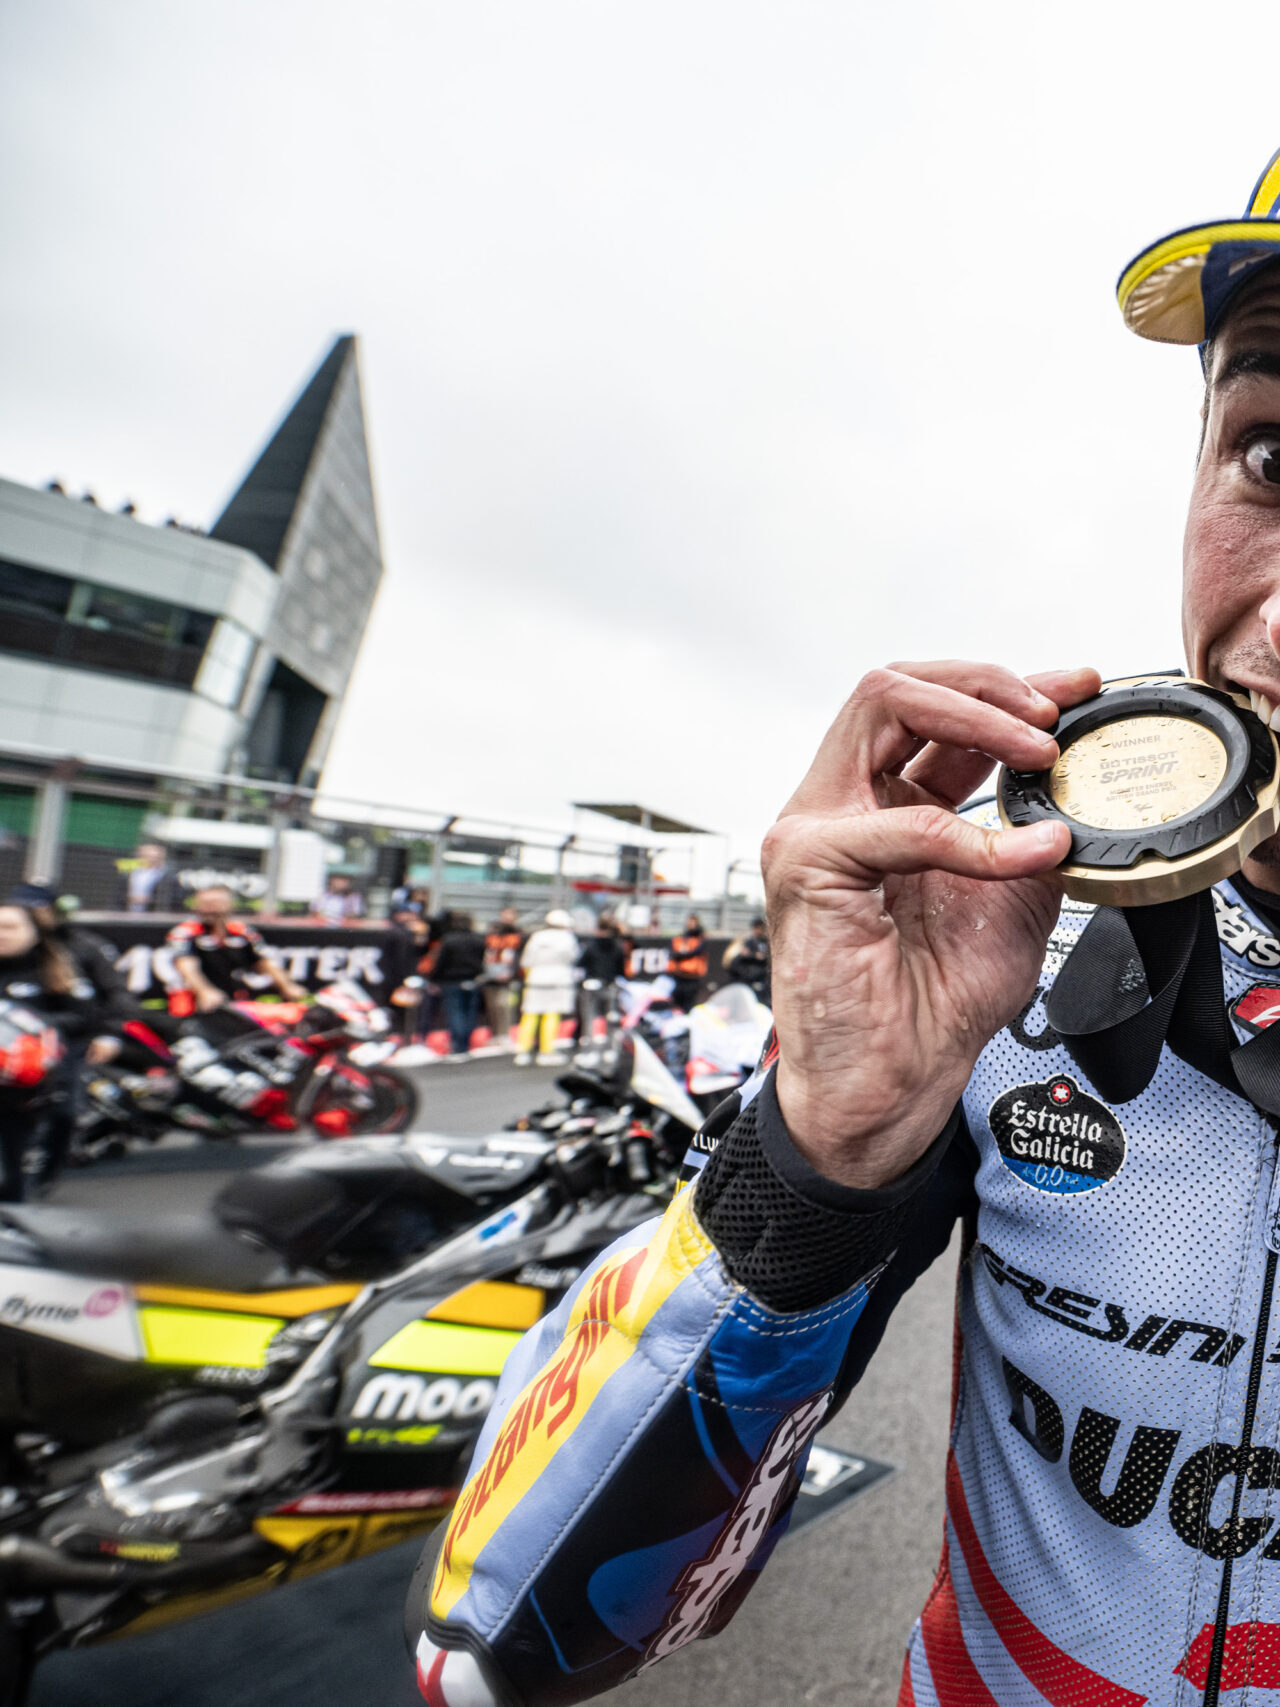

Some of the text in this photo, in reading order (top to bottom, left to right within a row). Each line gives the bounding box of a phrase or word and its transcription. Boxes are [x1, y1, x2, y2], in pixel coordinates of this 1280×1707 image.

[1112, 735, 1161, 749] WINNER
[1122, 751, 1178, 766] TISSOT
[1100, 761, 1178, 784] SPRINT
[1008, 1100, 1103, 1143] Estrella
[1010, 1128, 1094, 1169] Galicia
